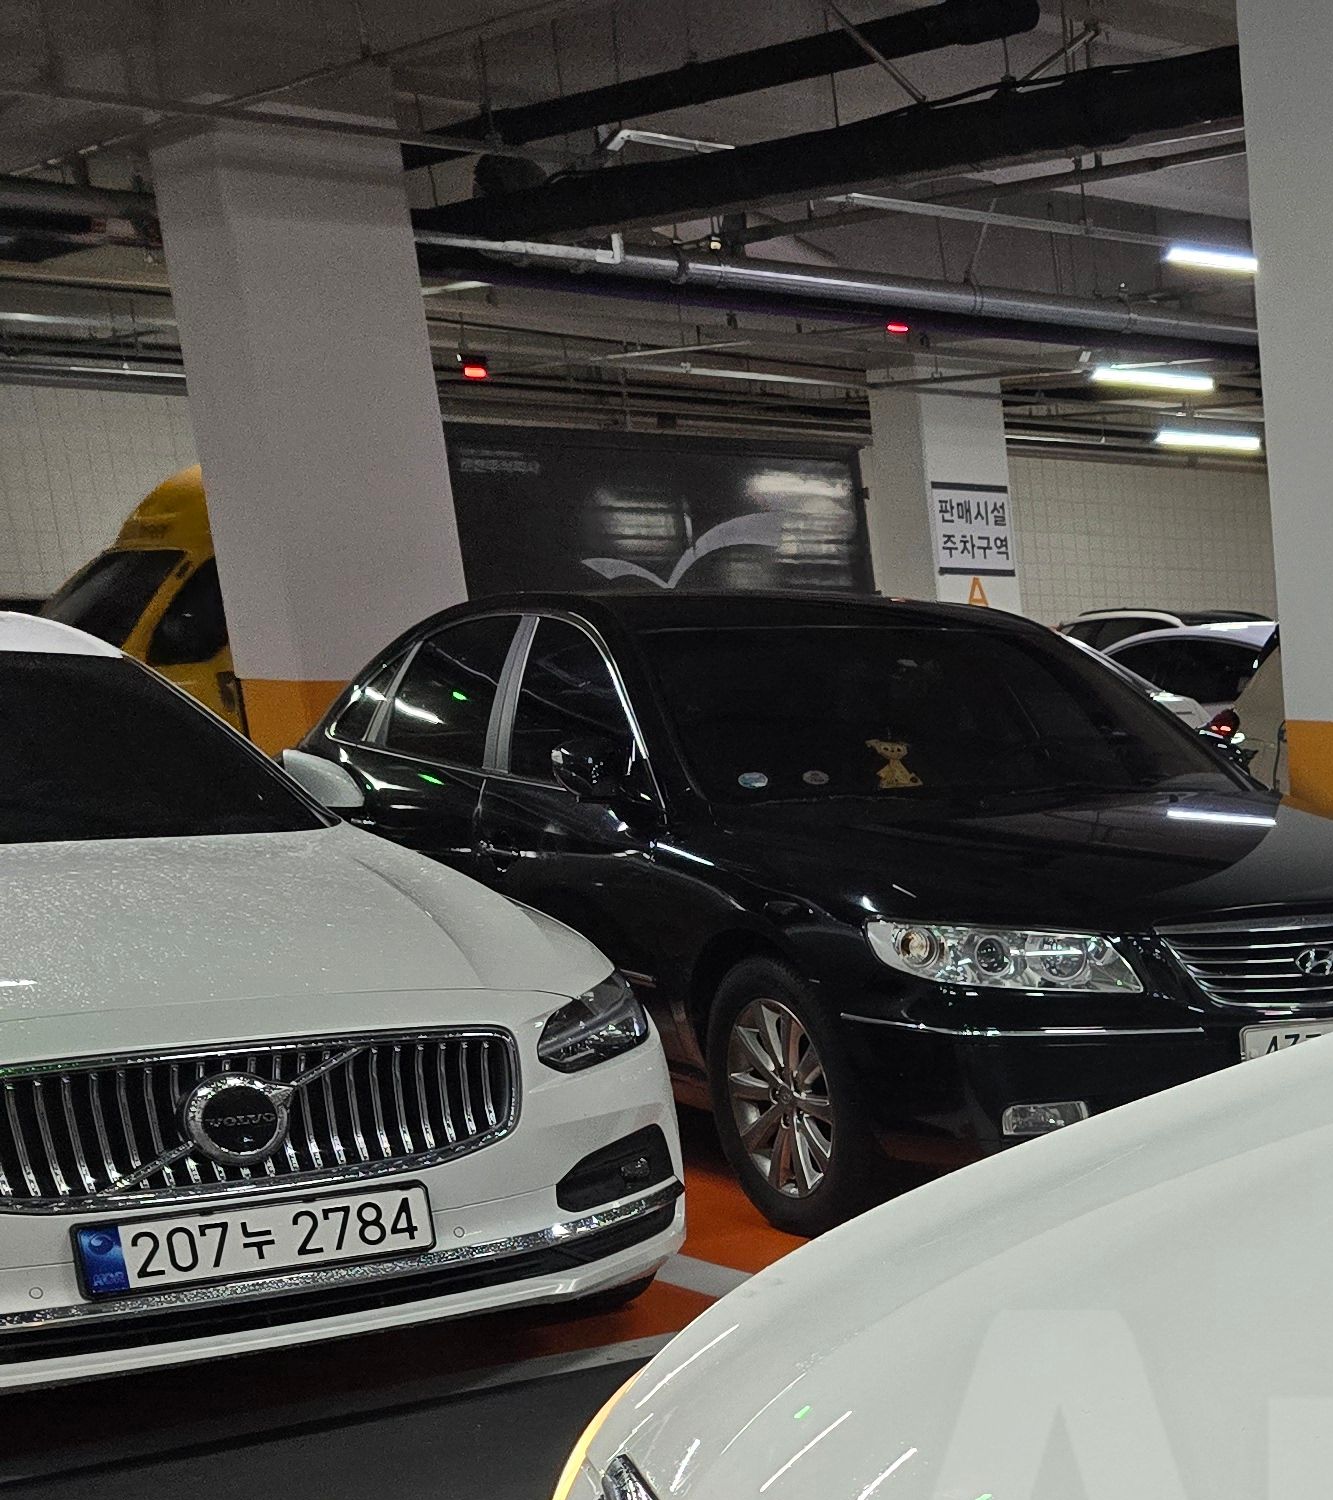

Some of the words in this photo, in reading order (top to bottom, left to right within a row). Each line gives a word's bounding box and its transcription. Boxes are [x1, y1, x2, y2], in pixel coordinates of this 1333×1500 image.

[938, 498, 1007, 527] 판매시설
[942, 534, 1010, 561] 주차구역
[967, 575, 989, 607] A
[130, 1221, 276, 1279] 207누
[292, 1197, 419, 1257] 2784
